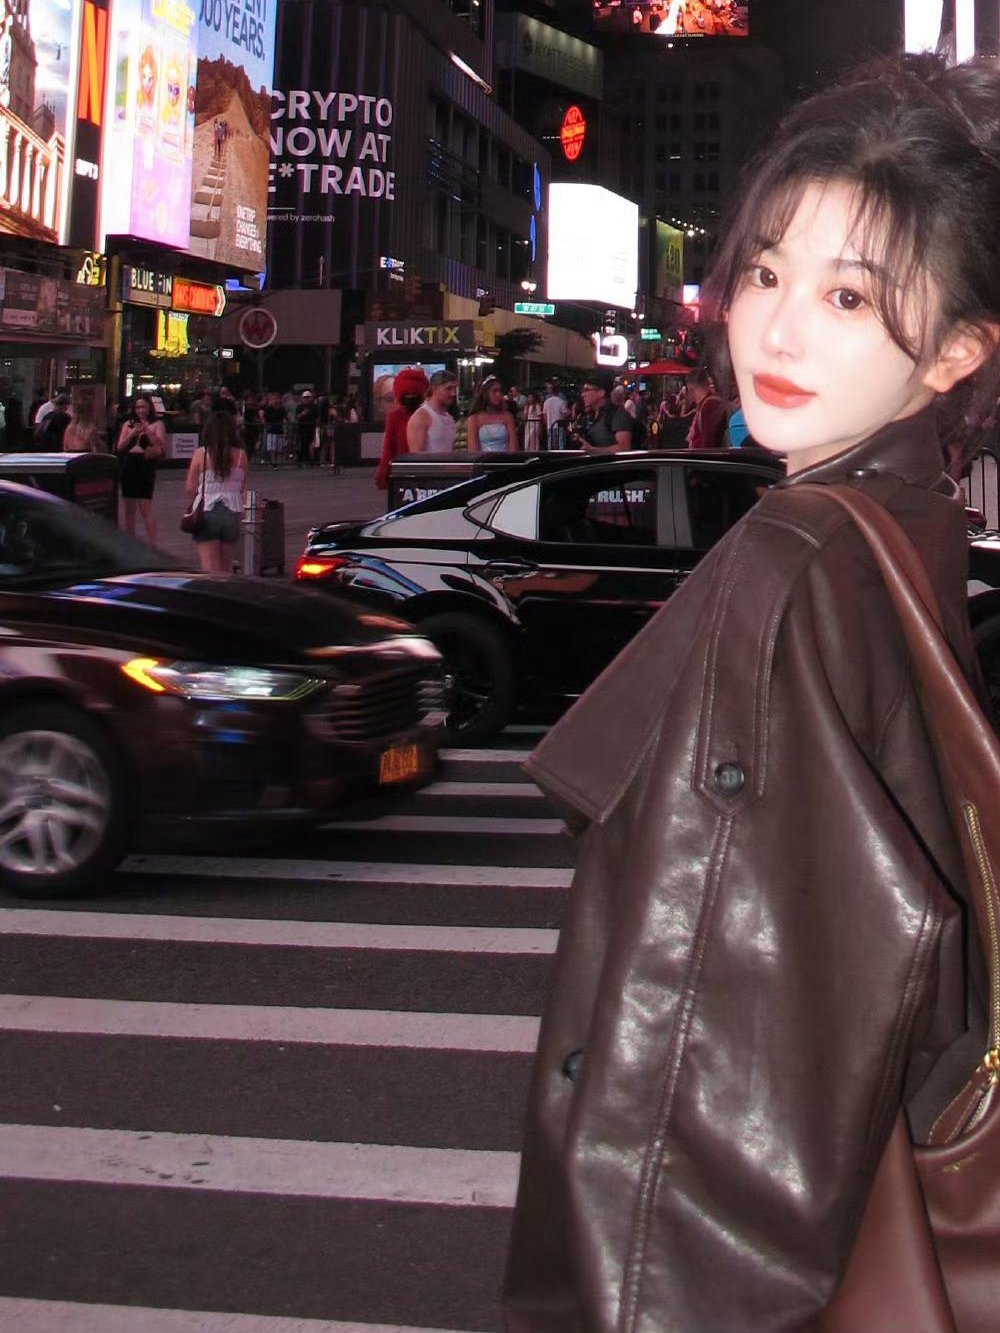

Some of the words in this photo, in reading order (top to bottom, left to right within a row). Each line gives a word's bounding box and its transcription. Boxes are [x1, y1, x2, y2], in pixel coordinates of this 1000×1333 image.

[224, 2, 266, 61] YEARS.
[271, 90, 393, 127] CRYPTO
[270, 127, 352, 158] NOW
[359, 131, 391, 163] AT
[131, 267, 154, 291] BLUE
[377, 327, 460, 345] KLIKTIX
